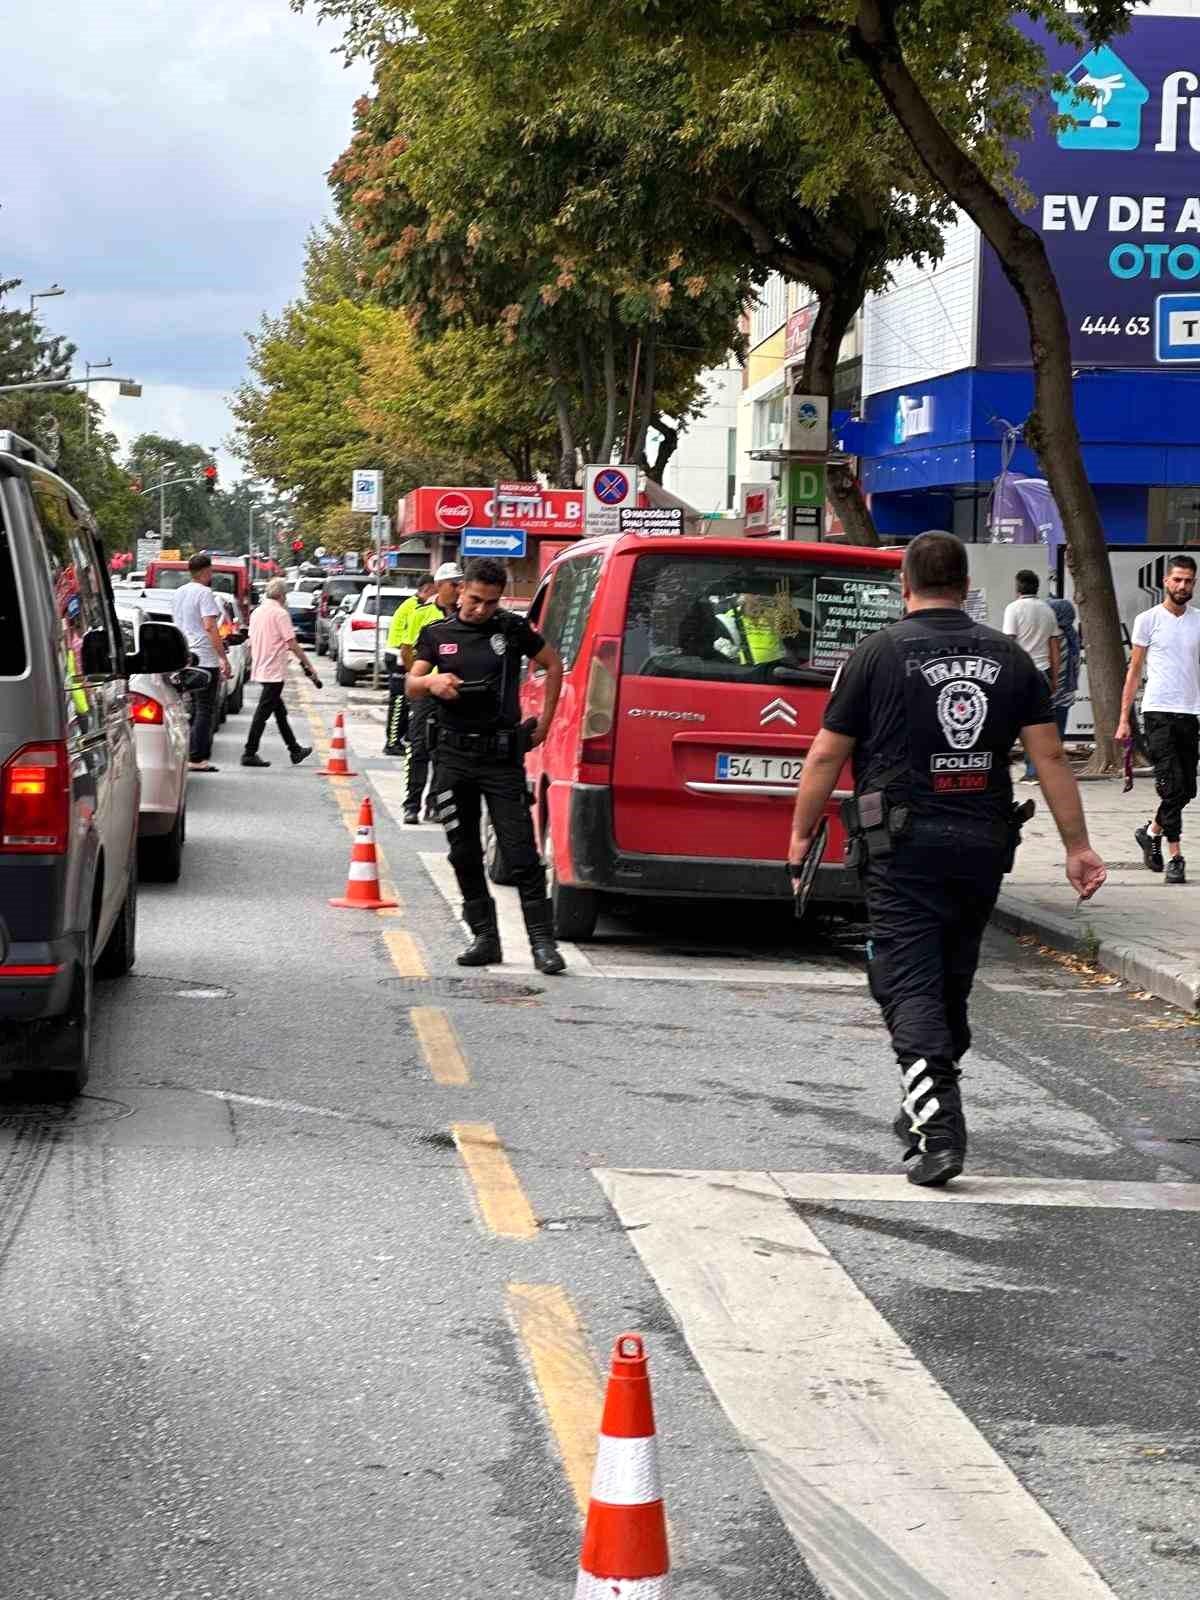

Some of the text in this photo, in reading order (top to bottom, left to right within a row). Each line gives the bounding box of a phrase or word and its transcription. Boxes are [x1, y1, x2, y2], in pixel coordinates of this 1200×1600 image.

[1042, 195, 1099, 231] EV
[1108, 196, 1166, 232] DE
[1080, 316, 1121, 335] 444
[924, 659, 998, 685] TRAFİK
[730, 759, 752, 777] 54
[760, 760, 772, 778] T
